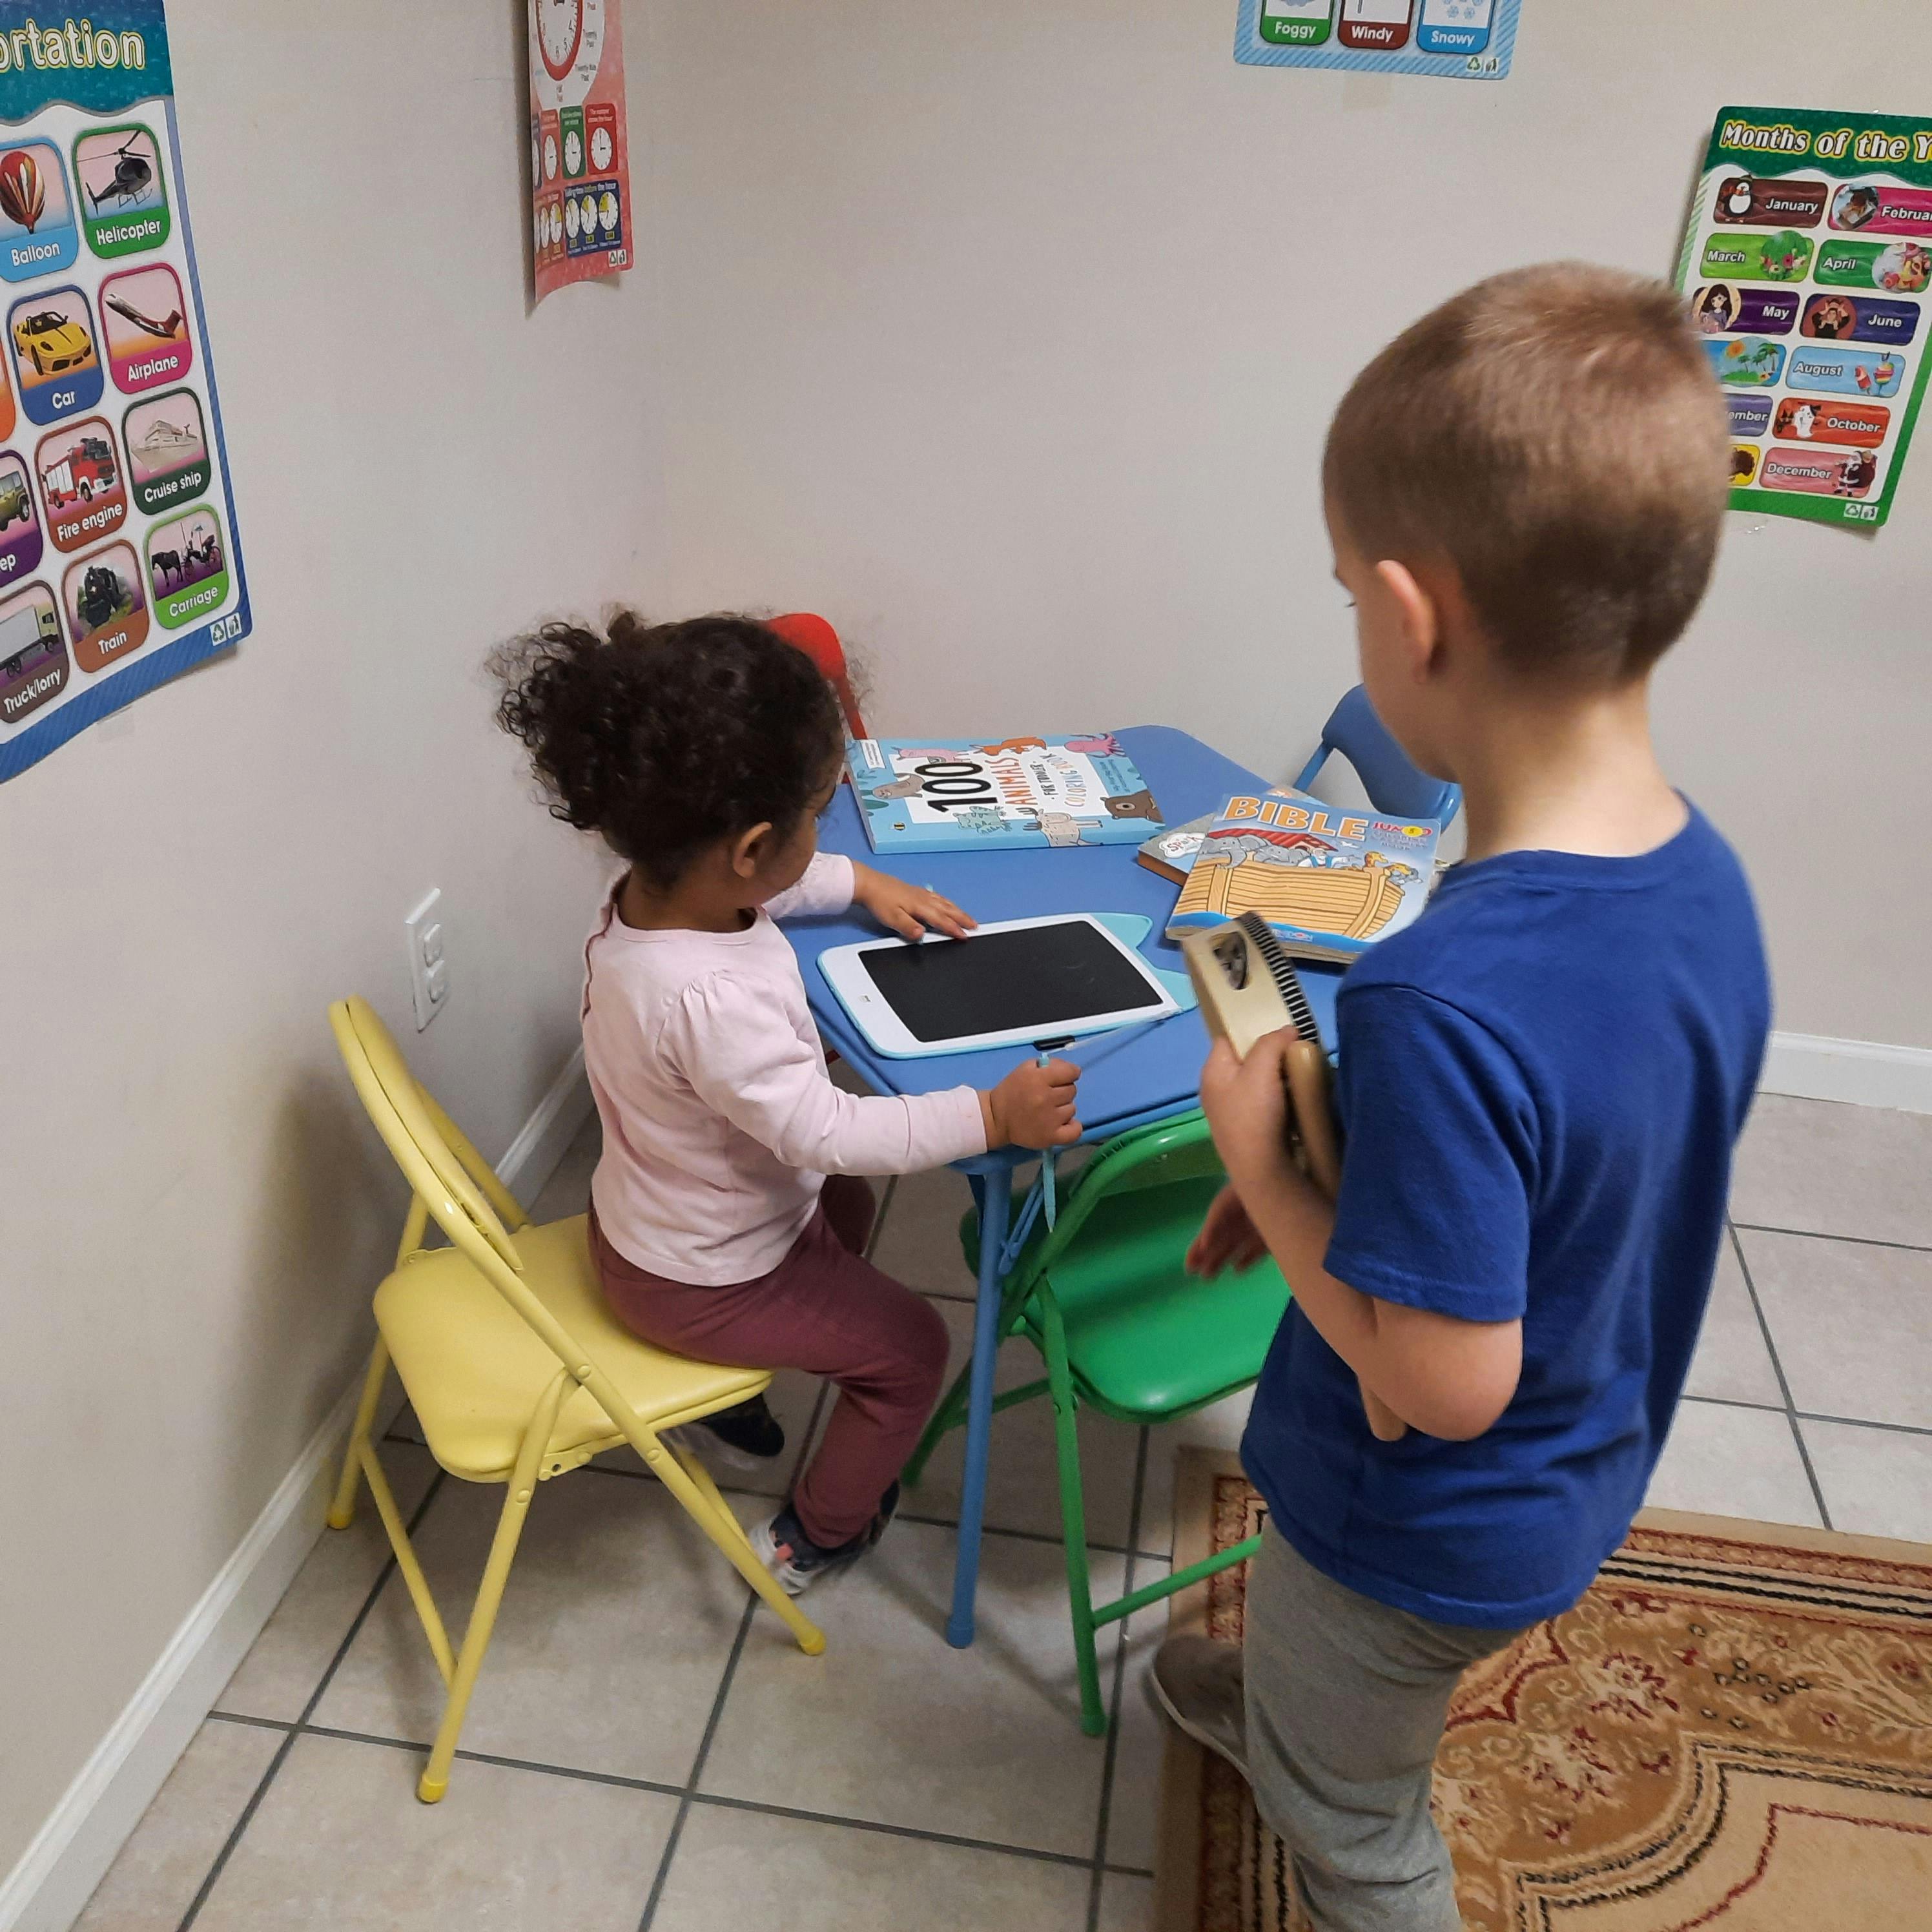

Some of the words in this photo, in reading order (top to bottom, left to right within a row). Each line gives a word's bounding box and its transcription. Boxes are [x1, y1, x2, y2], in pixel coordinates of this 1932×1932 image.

[1274, 21, 1317, 39] Foggy
[1351, 25, 1393, 43] Windy
[1431, 30, 1475, 46] Snowy
[1721, 123, 1807, 151] Months
[1817, 131, 1851, 156] of
[1857, 133, 1907, 159] the
[1765, 198, 1818, 214] January
[96, 219, 161, 246] Helicopter
[11, 242, 61, 267] Balloon
[1707, 250, 1745, 262] March
[1823, 258, 1856, 271] April
[1762, 305, 1790, 320] May
[1868, 314, 1902, 328] June
[128, 355, 179, 382] Airplane
[1793, 362, 1842, 376] August
[52, 390, 76, 409] Car
[1827, 417, 1880, 433] October
[1767, 463, 1832, 479] December
[144, 480, 178, 504] Cruise
[180, 471, 201, 489] ship
[57, 522, 79, 542] Fire
[82, 503, 123, 529] engine
[0, 553, 17, 572] ep
[169, 586, 218, 617] Carriage
[98, 631, 127, 655] Train
[4, 668, 61, 714] Truck/lorry
[914, 762, 998, 813] 100
[985, 757, 1038, 805] ANIMALS
[1041, 784, 1059, 796] FOR
[1224, 795, 1369, 841] BIBLE
[1372, 821, 1433, 836] JUMO
